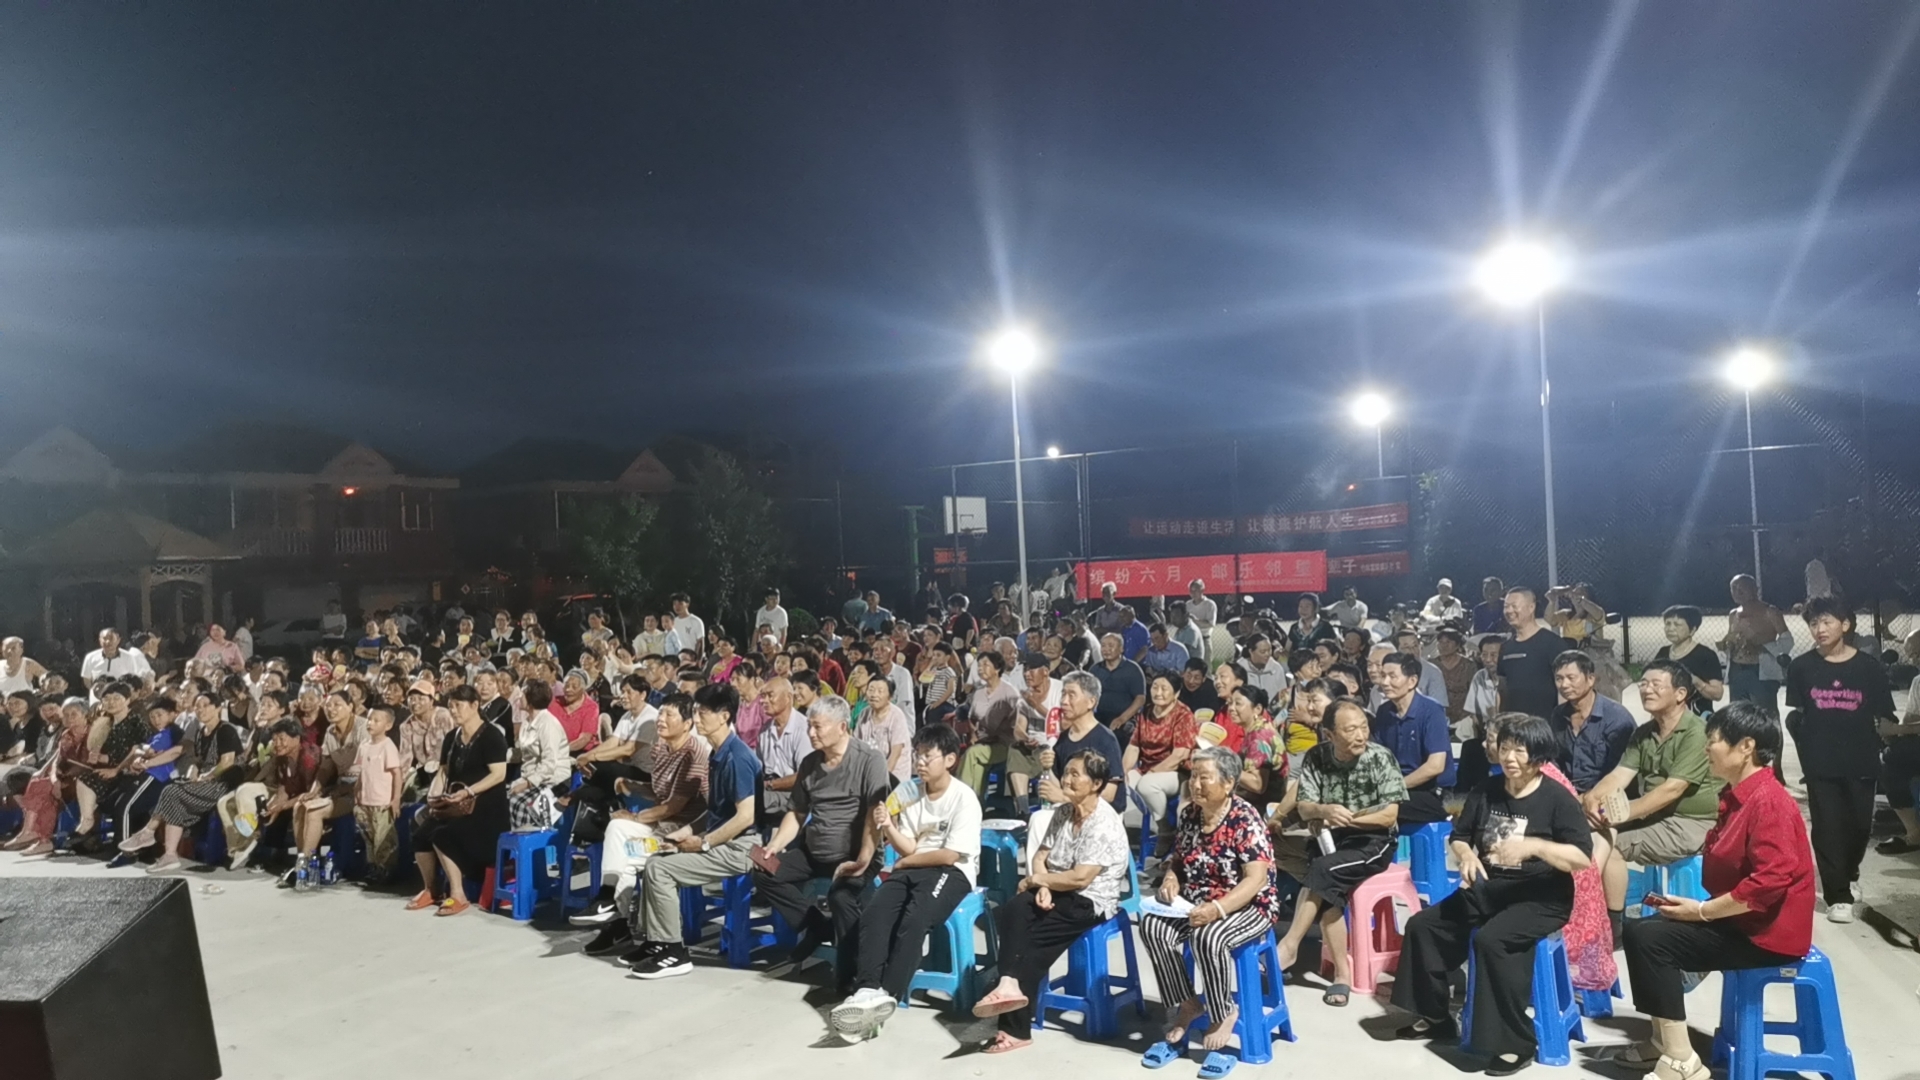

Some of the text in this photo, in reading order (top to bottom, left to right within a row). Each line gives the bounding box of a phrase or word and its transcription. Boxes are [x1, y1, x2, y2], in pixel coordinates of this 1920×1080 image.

[1089, 565, 1181, 585] 缤纷六月
[1036, 599, 1046, 610] 12
